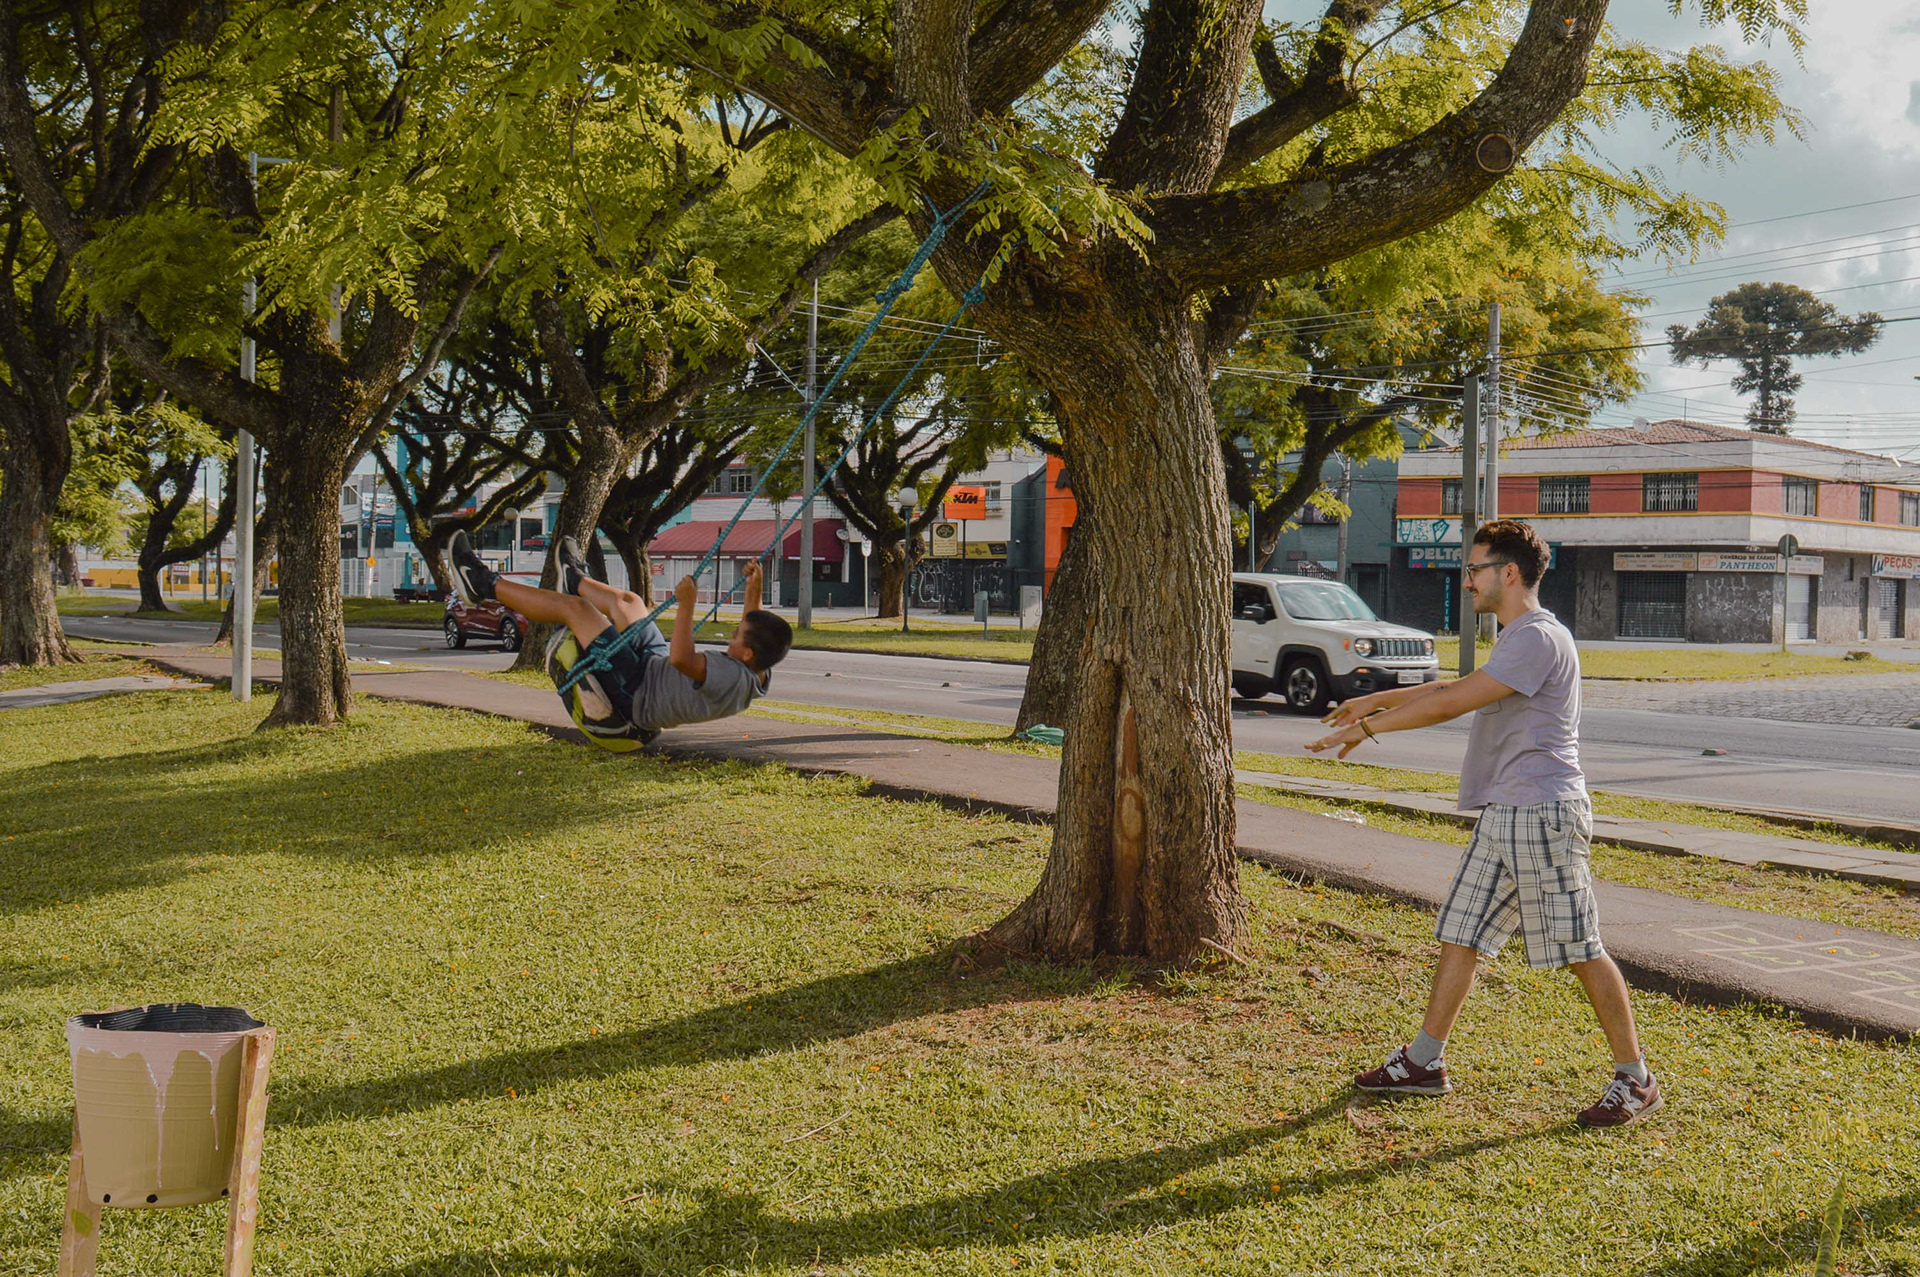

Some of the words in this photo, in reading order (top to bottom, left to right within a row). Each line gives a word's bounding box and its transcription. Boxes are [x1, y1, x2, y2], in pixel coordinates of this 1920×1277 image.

[954, 492, 978, 504] KTM
[1719, 561, 1776, 570] PANTHEON
[1884, 556, 1913, 571] PEÇAS
